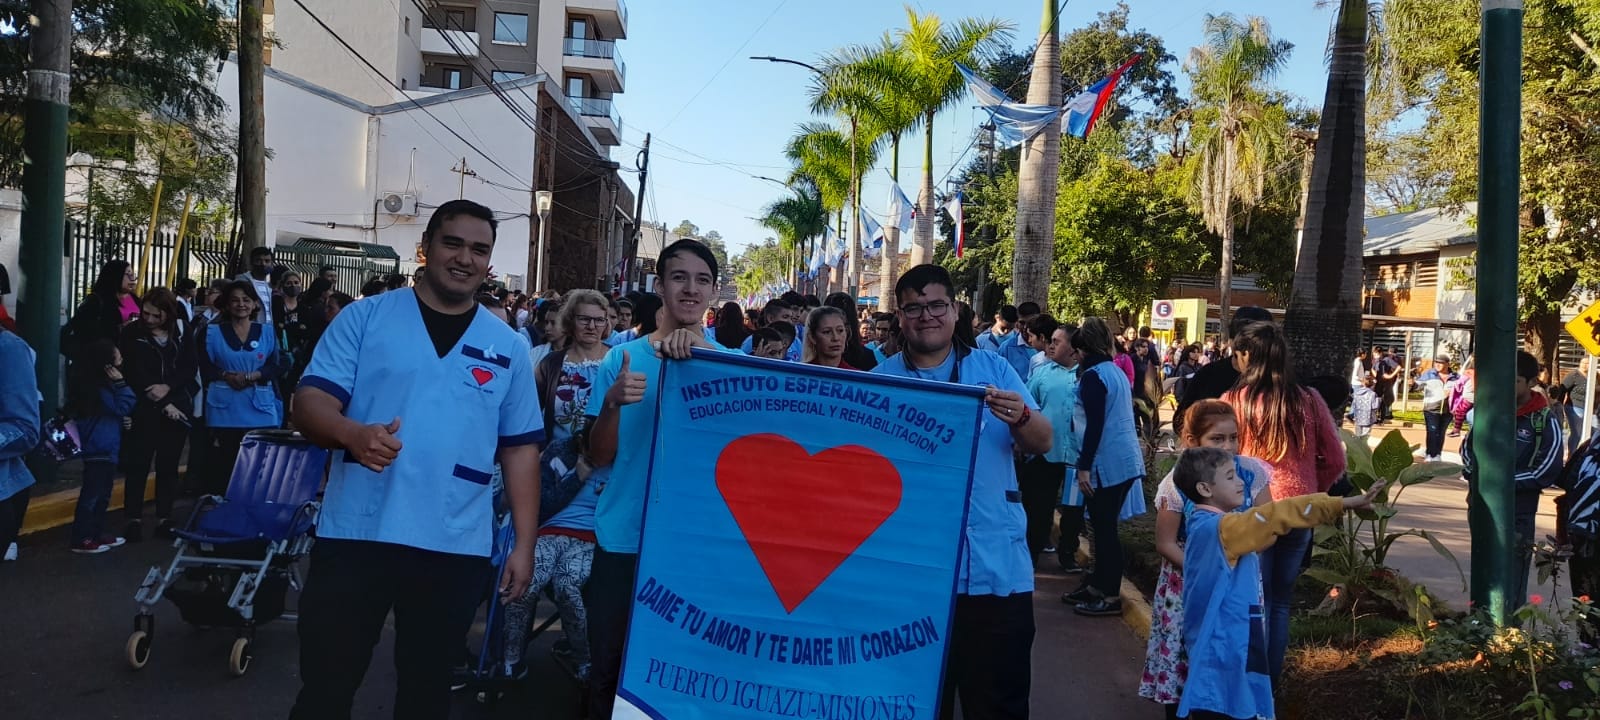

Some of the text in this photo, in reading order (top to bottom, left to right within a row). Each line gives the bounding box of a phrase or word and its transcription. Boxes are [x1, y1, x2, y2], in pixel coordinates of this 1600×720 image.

[1160, 304, 1168, 315] E
[681, 375, 956, 445] INSTITUTO ESPERANZA 109013
[689, 398, 939, 455] EDUCACION ESPECIAL Y REHABILITACION
[636, 576, 940, 666] DAME TU AMOR Y TE DARE MI CORAZON
[644, 657, 917, 720] PUERTO IGUAZU-MISIONES
